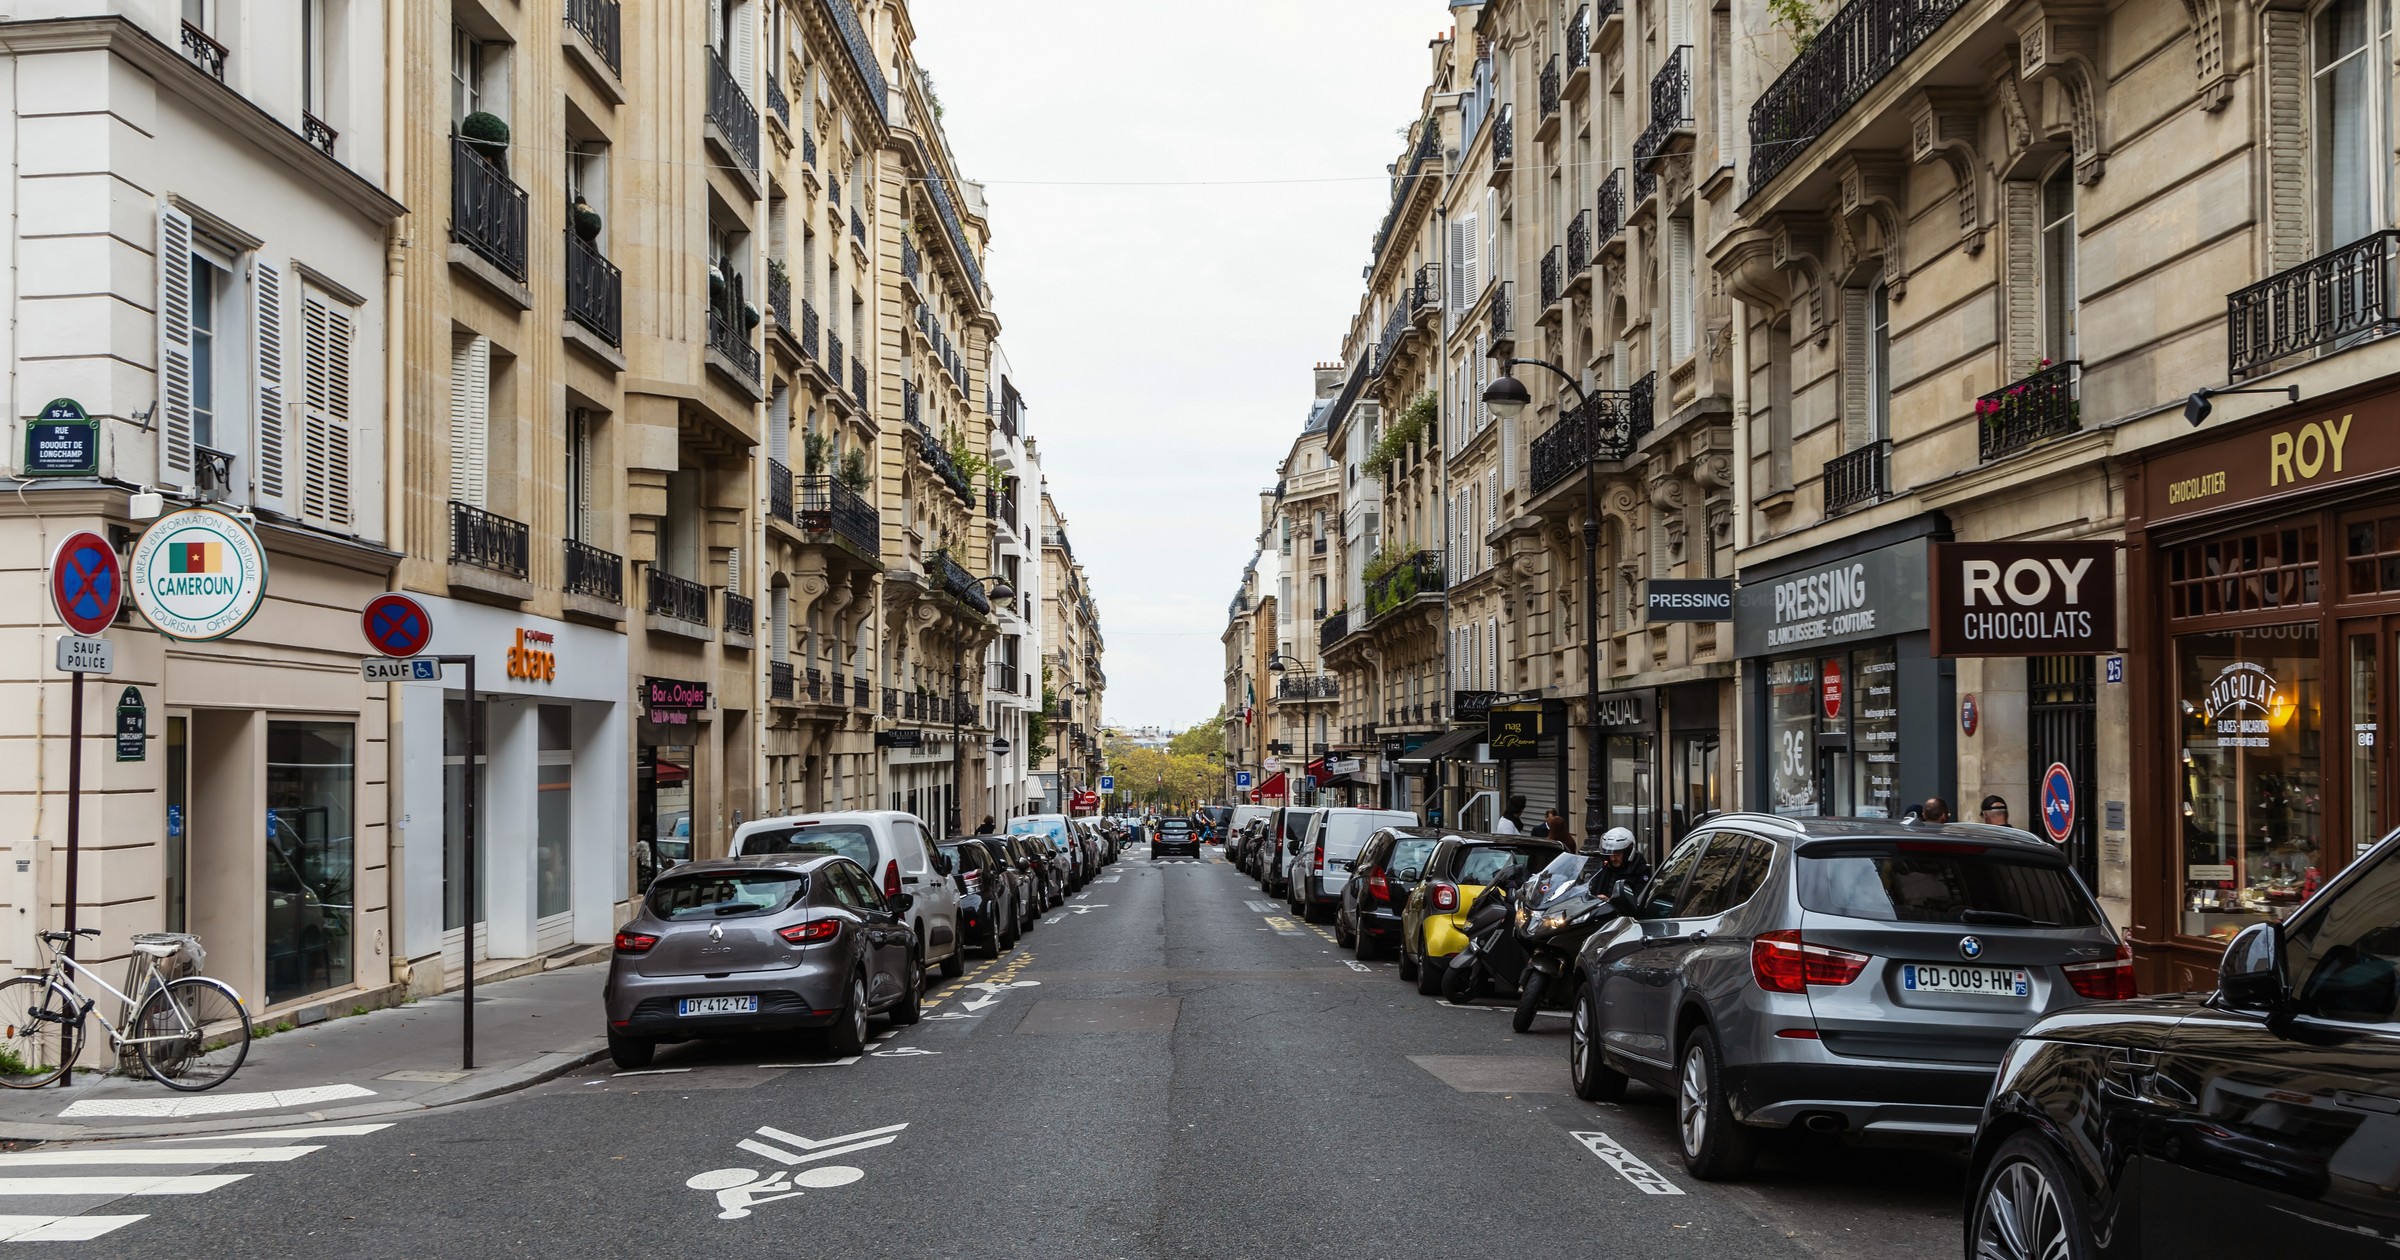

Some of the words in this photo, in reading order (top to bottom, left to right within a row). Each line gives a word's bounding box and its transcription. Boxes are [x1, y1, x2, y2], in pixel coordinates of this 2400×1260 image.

[40, 441, 72, 449] BOUQUET
[73, 441, 83, 449] DE
[40, 450, 83, 458] LONGCHAMP
[2271, 413, 2353, 487] ROY
[2169, 471, 2225, 504] CHOCOLATIER
[136, 546, 151, 584] BUREAU
[149, 515, 223, 546] d'INFORMATION
[224, 525, 255, 582] TOURISTIQUE
[158, 576, 233, 596] CAMEROUN
[1962, 558, 2095, 606] ROY
[1649, 593, 1730, 608] PRESSING
[1775, 563, 1866, 624] PRESSING
[150, 606, 197, 633] TOURISM
[206, 606, 243, 632] OFFICE
[1768, 621, 1827, 647] BLANCHISSERIE
[1833, 609, 1875, 636] COUTURE
[1963, 611, 2092, 640] CHOCOLATS
[74, 642, 101, 654] SAUF
[68, 655, 105, 669] POLICE
[367, 664, 409, 677] SAUF
[2107, 659, 2121, 681] 25
[1767, 664, 1792, 685] BLANC
[1794, 661, 1814, 682] BLEU
[652, 684, 666, 702] Bar
[673, 684, 704, 707] Ongles
[2204, 674, 2284, 718] CHOCOLATS
[1598, 699, 1640, 725] ASUAL
[1505, 723, 1521, 733] nag
[2217, 720, 2237, 733] GLACES
[2240, 720, 2269, 733] MACARONS
[1783, 730, 1805, 776] 3€
[1104, 779, 1110, 787] P
[1241, 774, 1247, 783] P
[701, 946, 731, 954] CLIO
[2065, 947, 2101, 956] X3
[1917, 967, 2013, 991] CD-009-HW
[2016, 984, 2026, 994] 75
[688, 997, 748, 1013] DY-412-YZ
